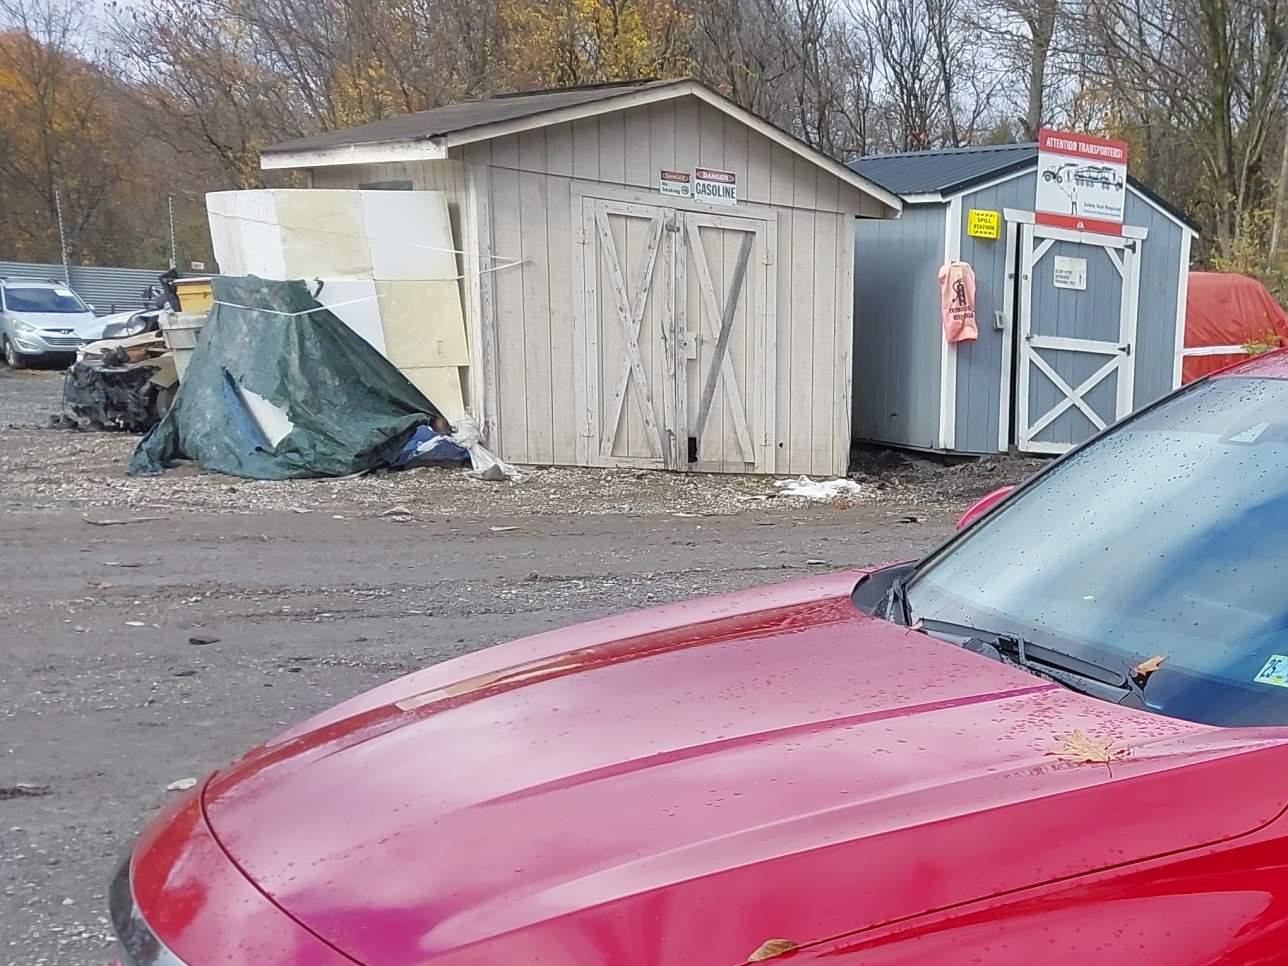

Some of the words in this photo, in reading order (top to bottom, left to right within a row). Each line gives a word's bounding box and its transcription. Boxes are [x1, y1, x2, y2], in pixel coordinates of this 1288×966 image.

[1046, 137, 1077, 152] ATTENTION
[1078, 142, 1123, 159] TRANSPORTERS!
[702, 171, 729, 182] DANGER
[695, 182, 736, 199] GASOLINE
[973, 223, 995, 231] STATION
[977, 217, 992, 225] SPILL
[1260, 658, 1282, 678] 25
